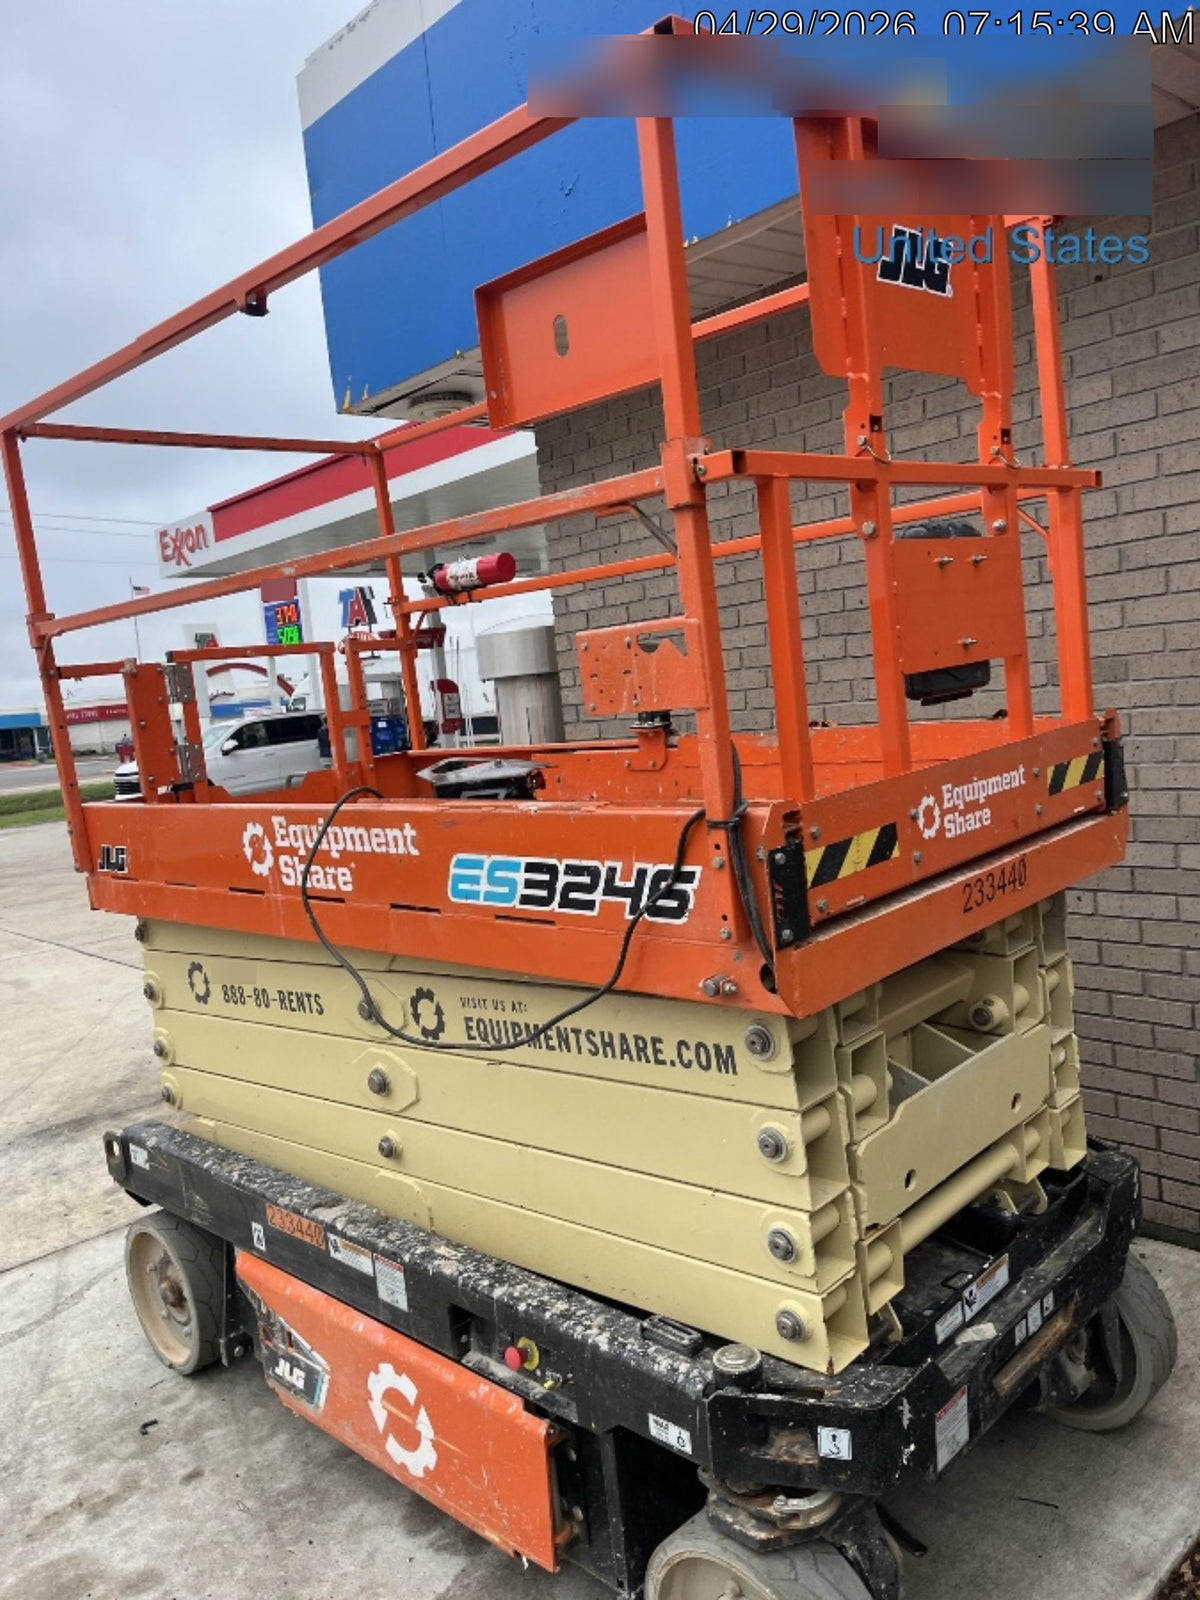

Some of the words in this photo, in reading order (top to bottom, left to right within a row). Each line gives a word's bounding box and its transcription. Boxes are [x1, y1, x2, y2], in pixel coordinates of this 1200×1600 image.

[877, 224, 952, 297] JLG
[159, 524, 209, 567] Exxon
[941, 764, 1026, 810] Equipment
[271, 815, 420, 859] Equipment
[943, 807, 991, 839] Share
[97, 844, 128, 874] JLG
[278, 854, 354, 892] Share
[449, 854, 702, 925] ES3246
[962, 857, 1028, 914] 233440
[221, 984, 325, 1016] 888-80-RENTS
[459, 996, 488, 1011] VISIT
[492, 999, 507, 1013] US
[511, 1001, 528, 1013] AT:
[463, 1016, 739, 1076] EQUIPMENTSHARE.COM
[268, 1203, 326, 1249] 233440
[274, 1357, 307, 1390] JLG
